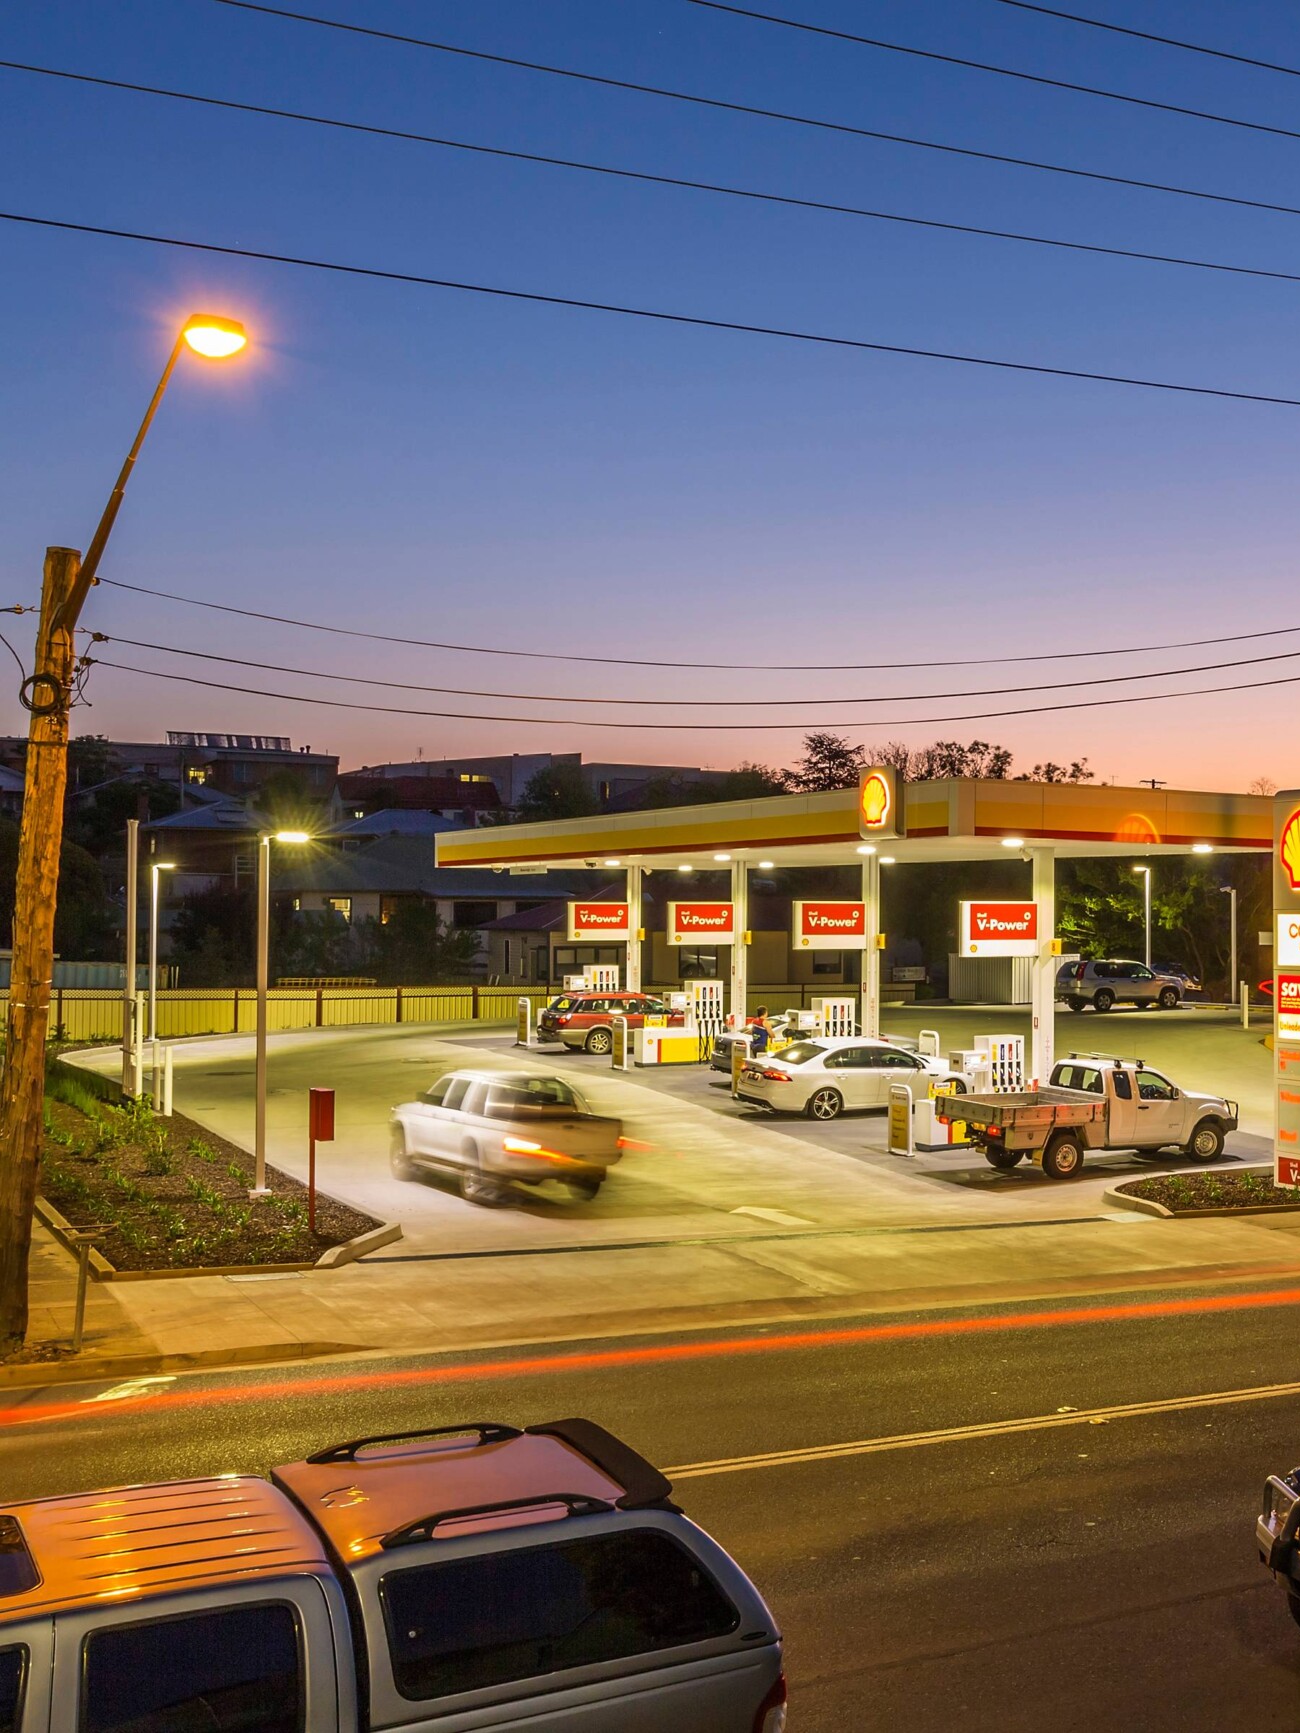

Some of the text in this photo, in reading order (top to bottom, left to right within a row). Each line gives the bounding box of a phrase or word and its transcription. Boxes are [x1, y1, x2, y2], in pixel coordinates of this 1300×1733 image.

[580, 914, 622, 923] V-Power
[681, 915, 726, 925] V-Power
[808, 916, 857, 927] V-Power
[976, 918, 1029, 931] V-Power
